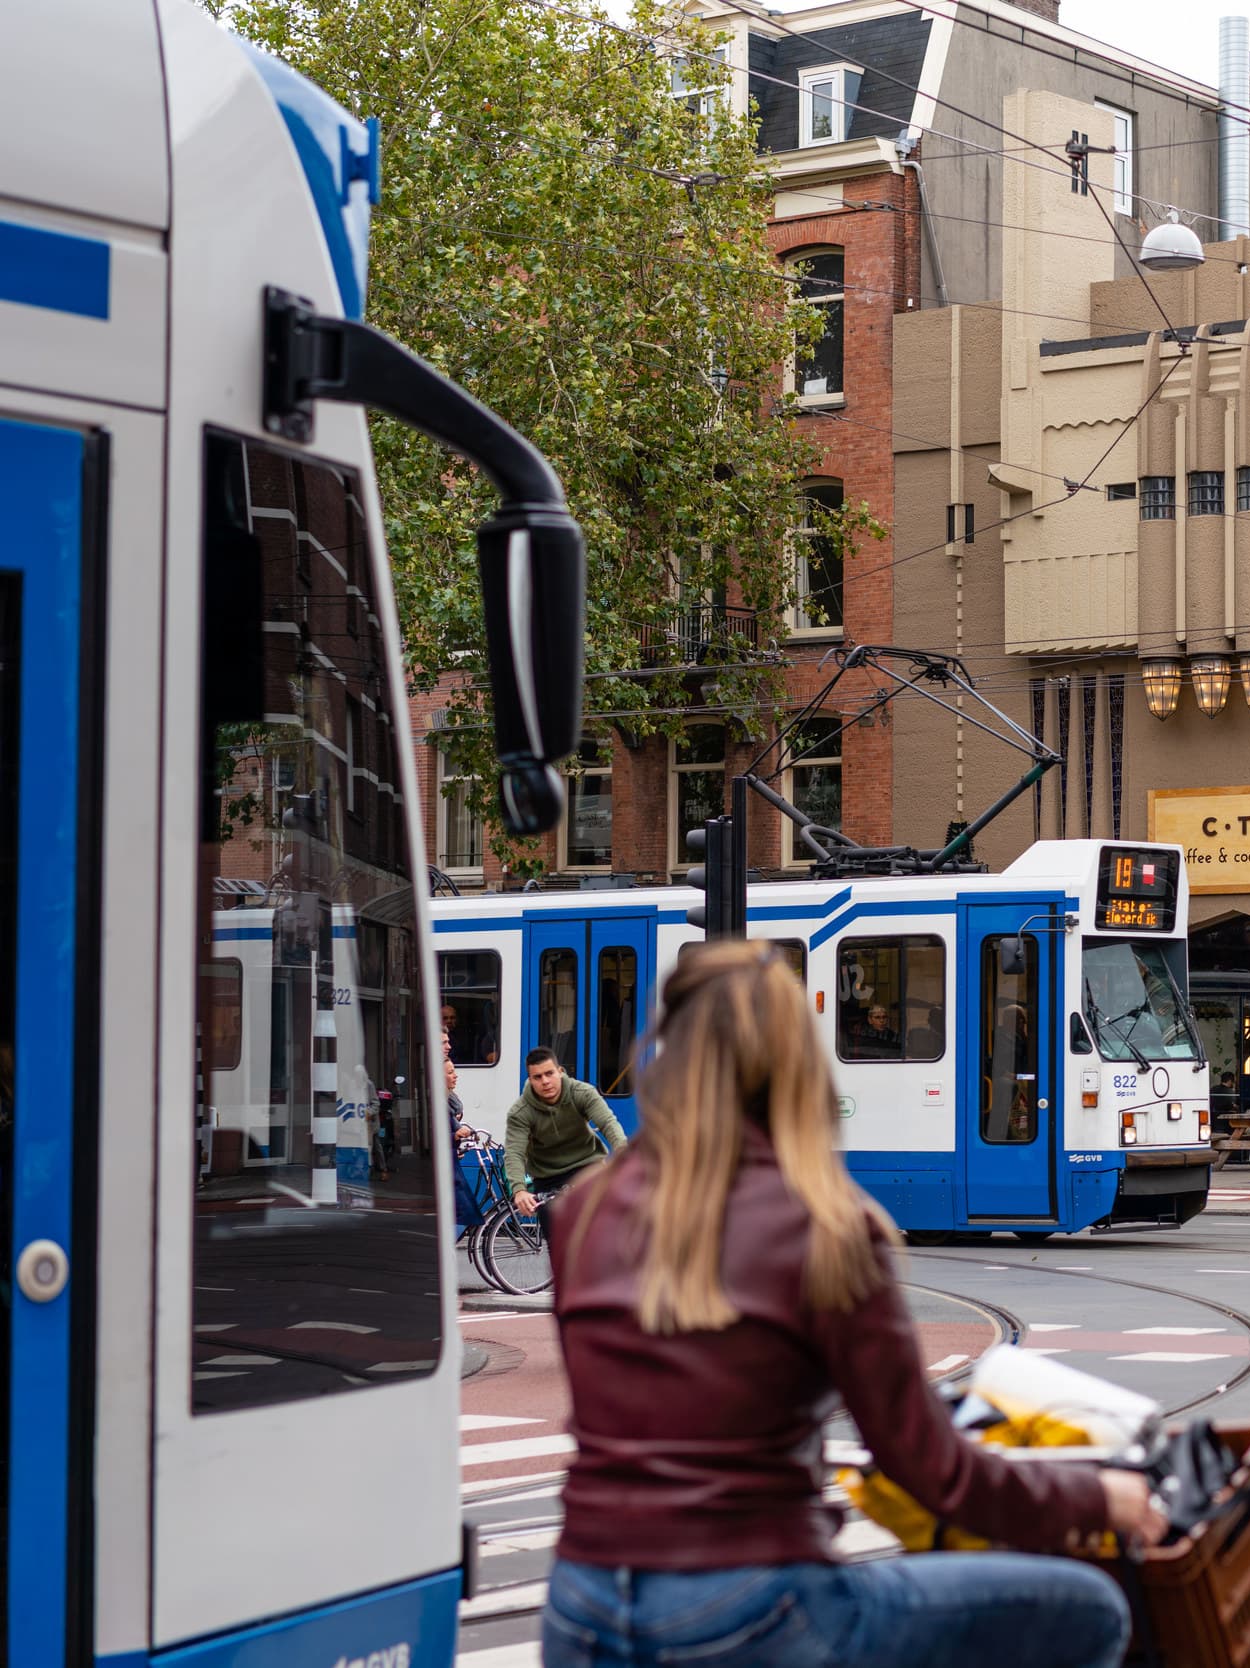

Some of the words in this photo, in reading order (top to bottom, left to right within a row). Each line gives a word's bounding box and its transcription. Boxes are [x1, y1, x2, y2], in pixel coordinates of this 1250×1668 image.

[1184, 848, 1212, 863] ffee
[1219, 847, 1228, 863] &
[1115, 858, 1132, 887] 19
[1113, 1075, 1137, 1088] 822
[1085, 1154, 1103, 1162] GVB
